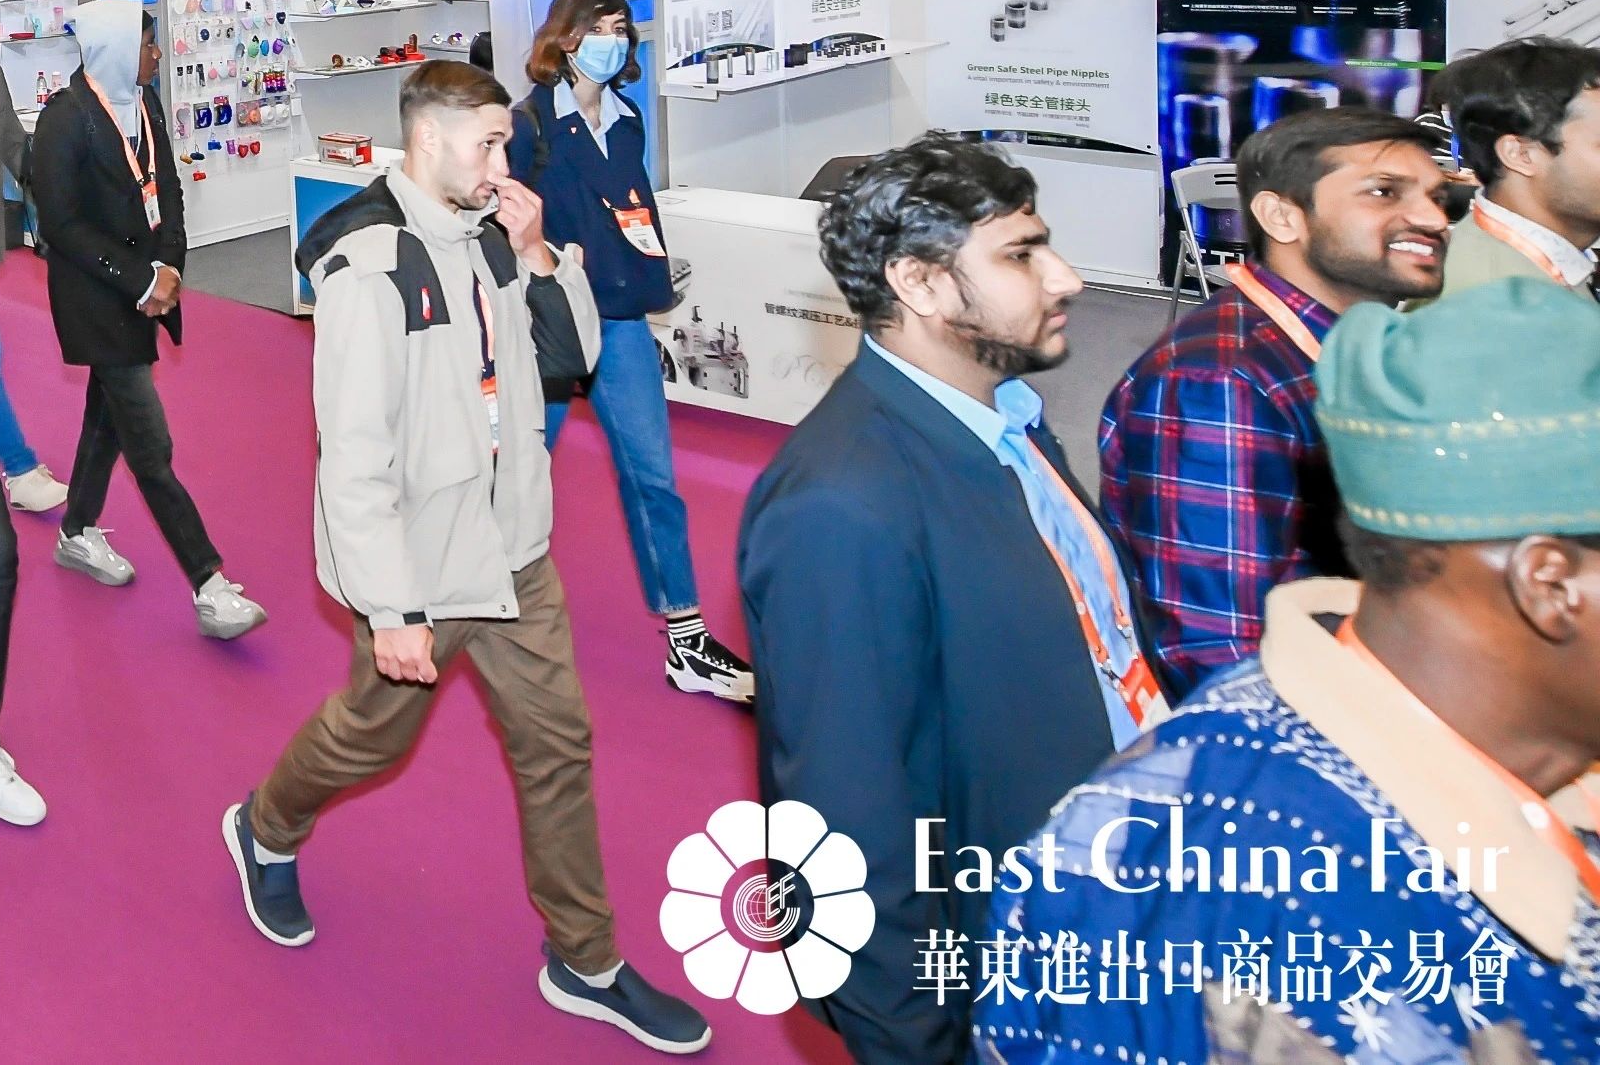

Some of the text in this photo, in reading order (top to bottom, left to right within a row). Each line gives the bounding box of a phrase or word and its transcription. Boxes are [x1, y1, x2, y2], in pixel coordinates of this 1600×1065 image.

[967, 63, 1110, 79] Green Safe Steel Pipe Nipples
[985, 92, 1091, 113] 绿色安全管接头
